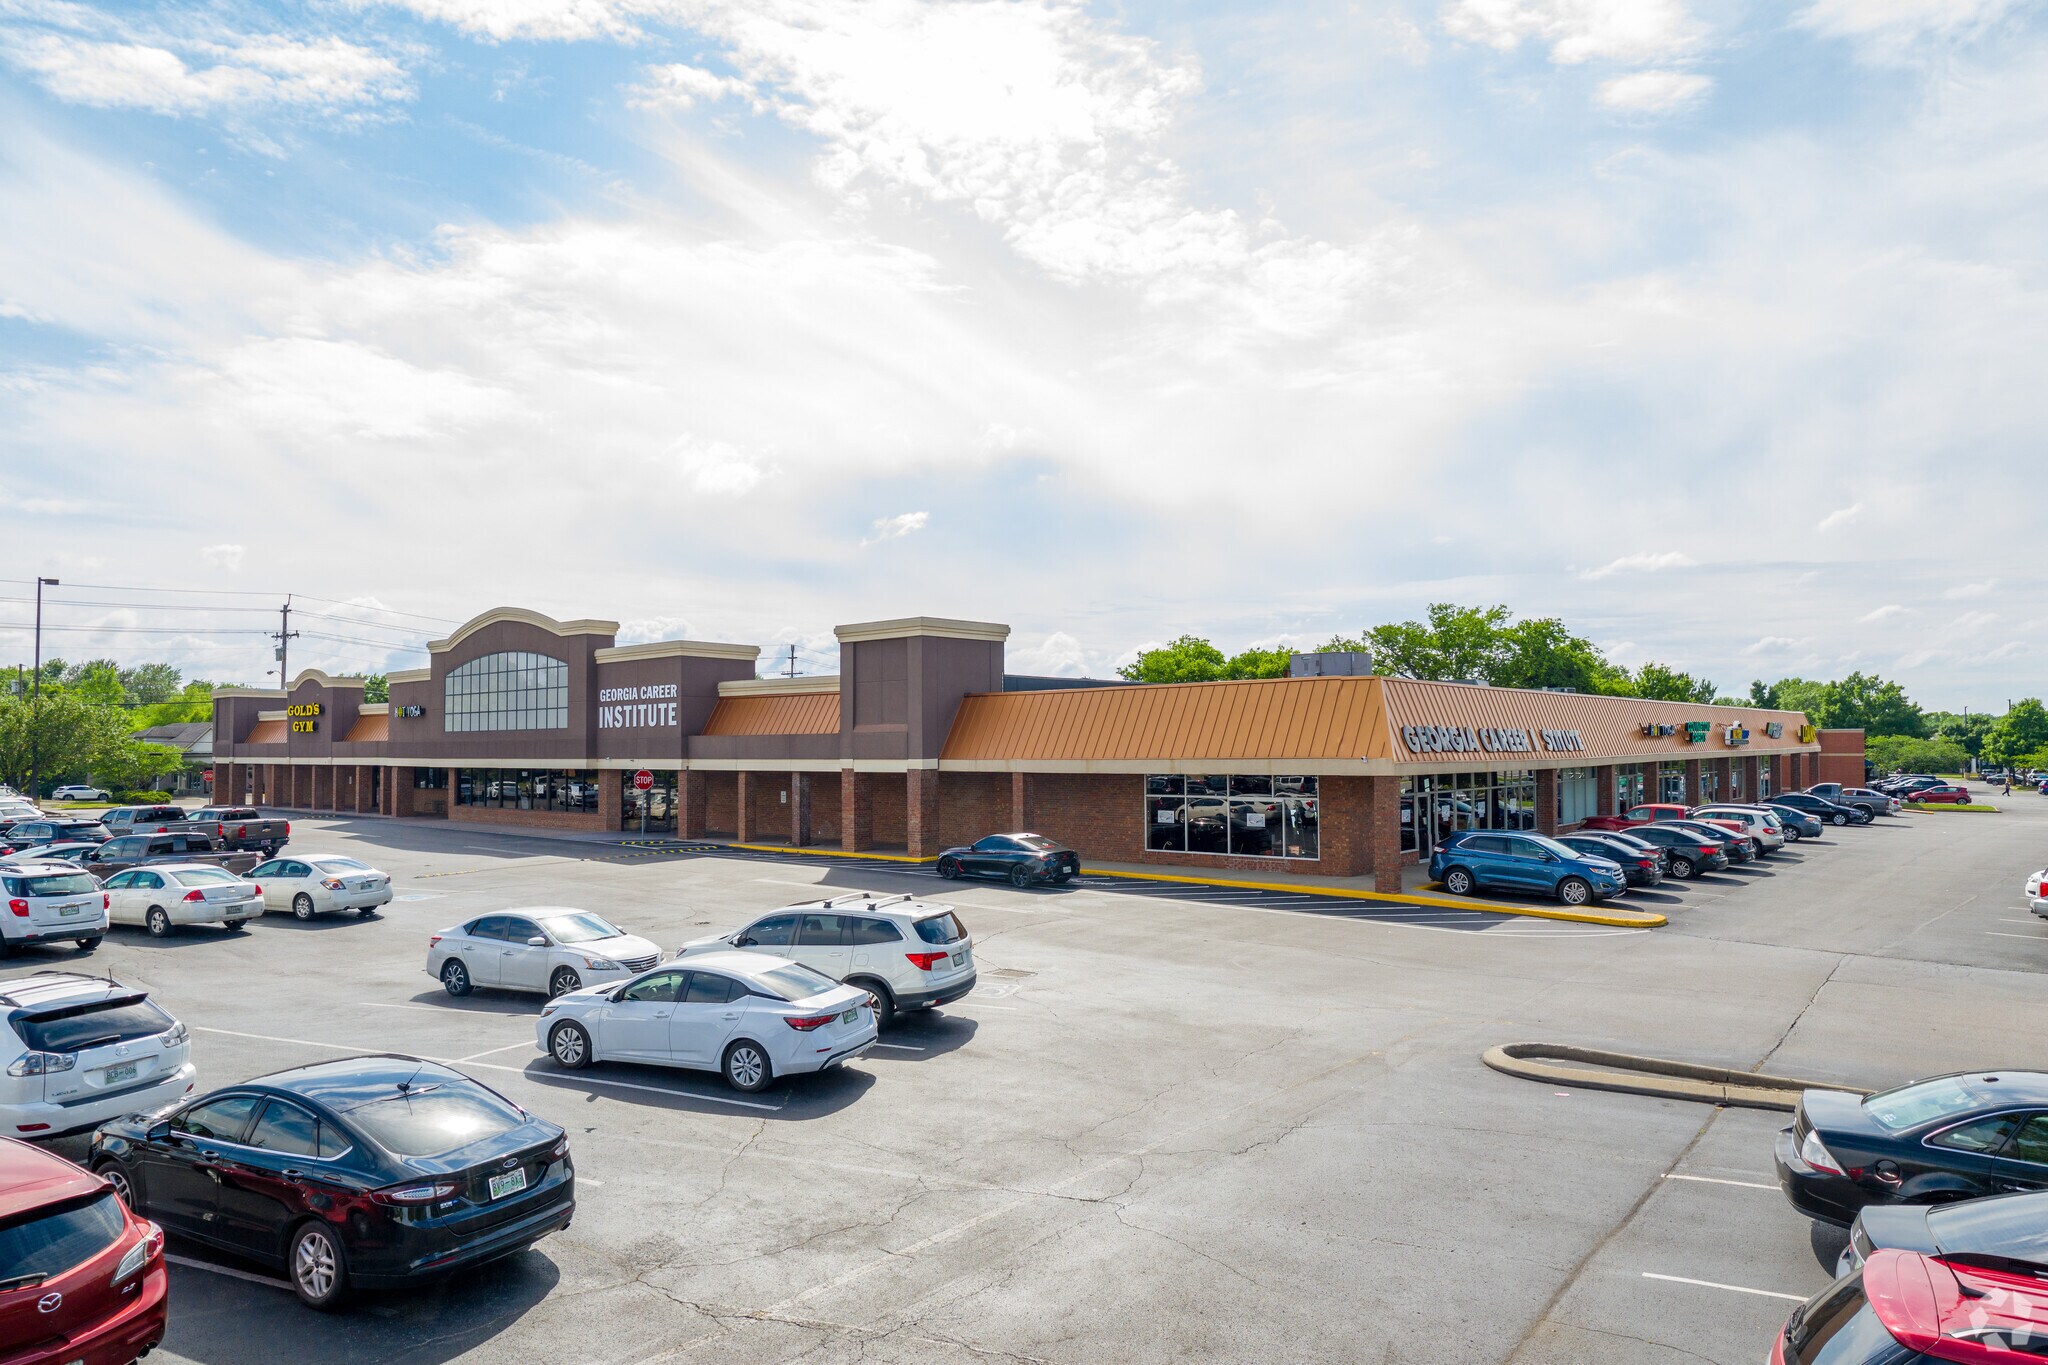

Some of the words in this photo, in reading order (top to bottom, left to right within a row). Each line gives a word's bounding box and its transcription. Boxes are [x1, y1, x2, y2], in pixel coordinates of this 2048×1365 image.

[600, 687, 638, 702] GEORGIA
[640, 684, 677, 699] CAREER
[288, 702, 320, 716] GOLD'S
[599, 703, 677, 728] INSTITUTE
[292, 721, 314, 732] GYM
[1402, 724, 1481, 753] GEORGIA
[1478, 727, 1532, 752] CAREER
[635, 776, 652, 784] STOP
